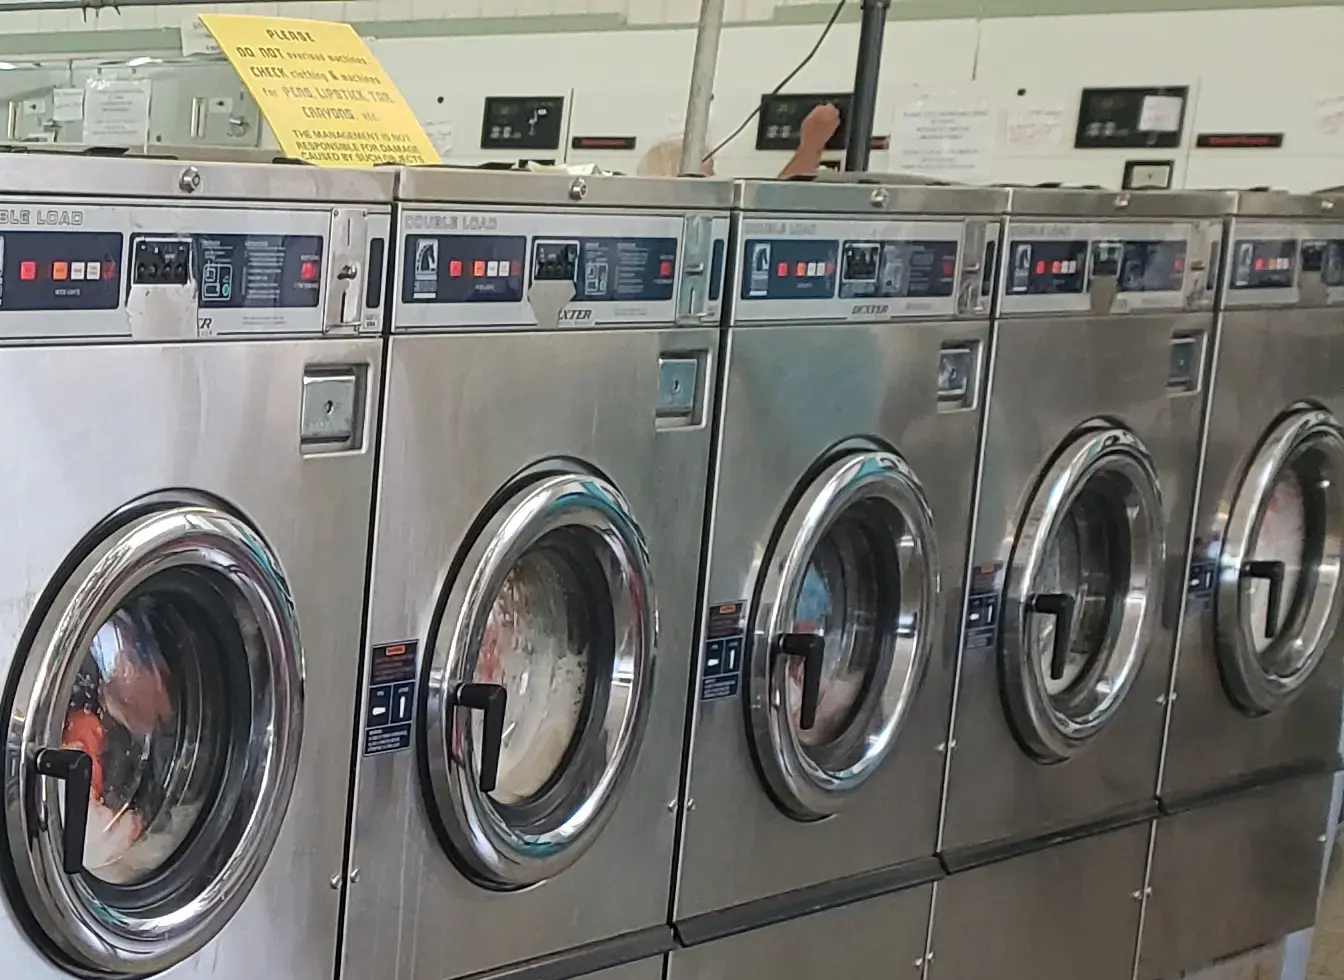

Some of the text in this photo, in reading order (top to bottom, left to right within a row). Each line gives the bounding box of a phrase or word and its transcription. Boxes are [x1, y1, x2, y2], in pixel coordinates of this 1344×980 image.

[266, 29, 316, 42] PLEASE
[236, 47, 255, 57] DO
[259, 47, 284, 59] NOT
[286, 52, 325, 61] overload
[250, 66, 287, 77] CHECK
[328, 70, 339, 80] &
[340, 73, 381, 84] machines
[263, 88, 277, 96] for
[292, 130, 312, 138] THE
[313, 131, 379, 140] MANAGEMENT
[393, 133, 411, 142] NOT
[296, 142, 419, 154] RESPONSIBLE FOR DAMAGE
[301, 152, 340, 161] CAUSED
[355, 154, 380, 162] SUCH
[37, 210, 83, 225] LOAD
